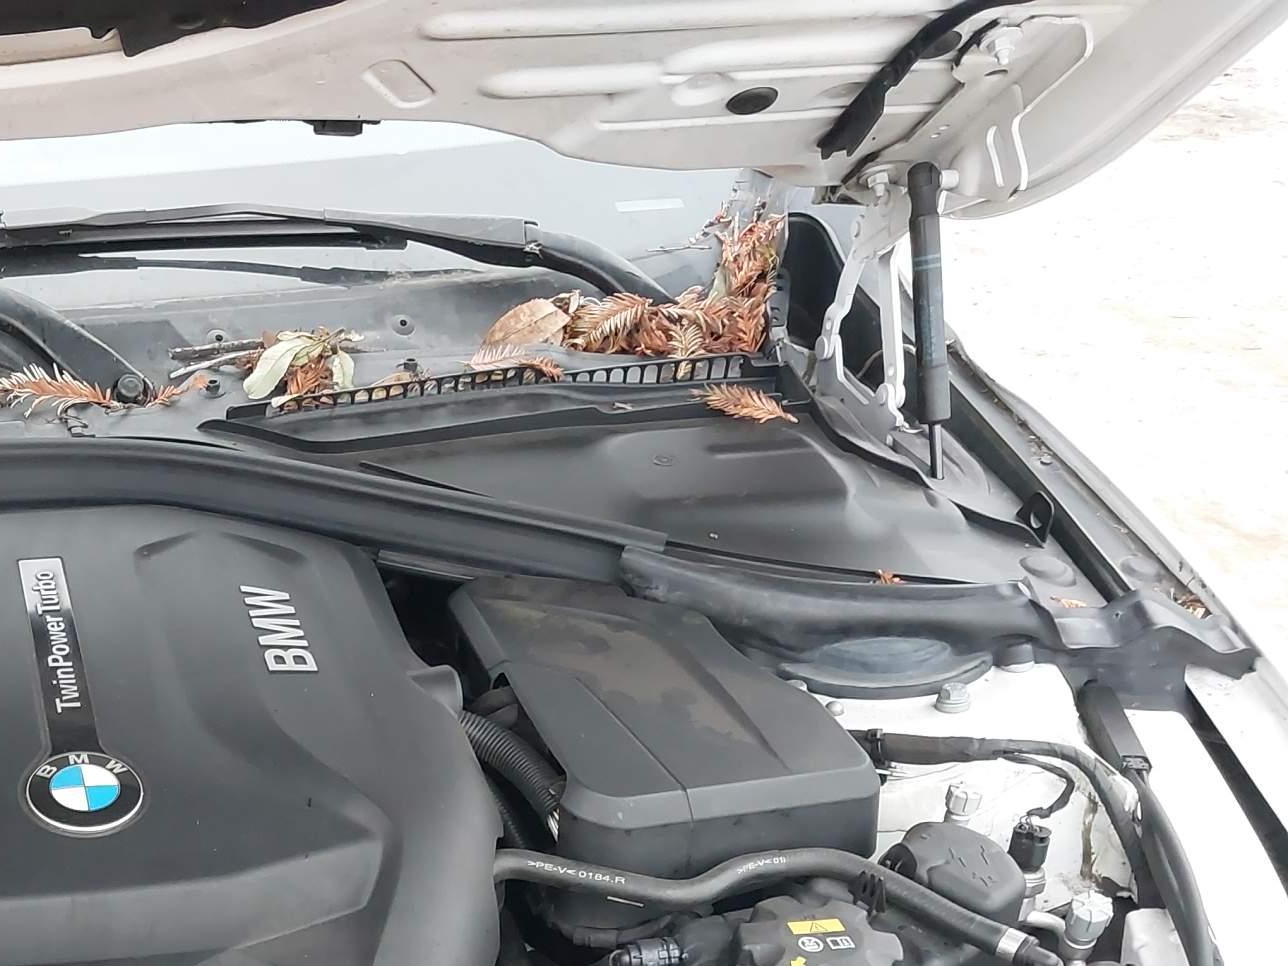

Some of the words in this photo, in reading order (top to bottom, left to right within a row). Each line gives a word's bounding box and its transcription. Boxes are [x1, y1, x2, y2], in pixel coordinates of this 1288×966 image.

[32, 570, 61, 615] Turbo
[239, 585, 318, 671] BMW
[45, 615, 81, 713] TwinPower
[36, 752, 128, 779] BMW
